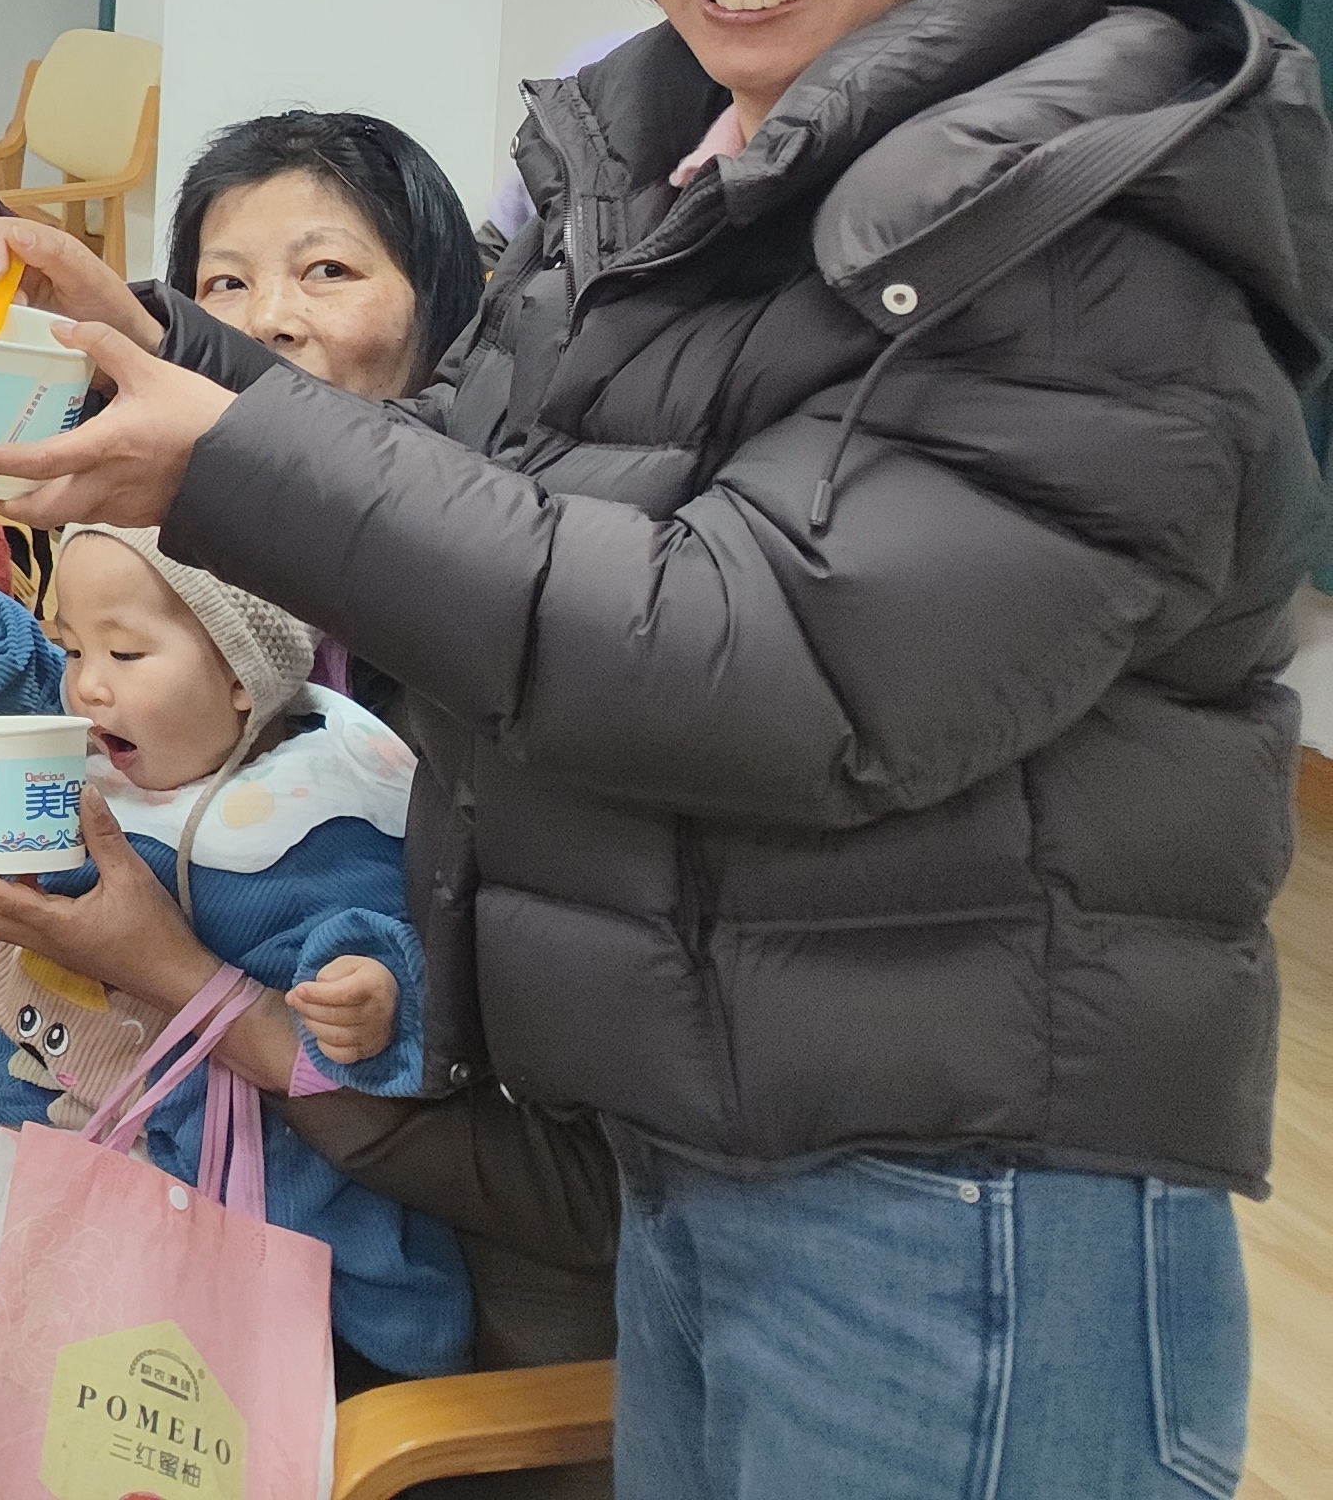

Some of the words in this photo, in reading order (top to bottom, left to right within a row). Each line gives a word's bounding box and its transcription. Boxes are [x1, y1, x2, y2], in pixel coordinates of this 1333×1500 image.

[25, 770, 66, 784] Delicious
[77, 1383, 232, 1466] POMELO
[109, 1432, 203, 1489] 三红蜜柚
